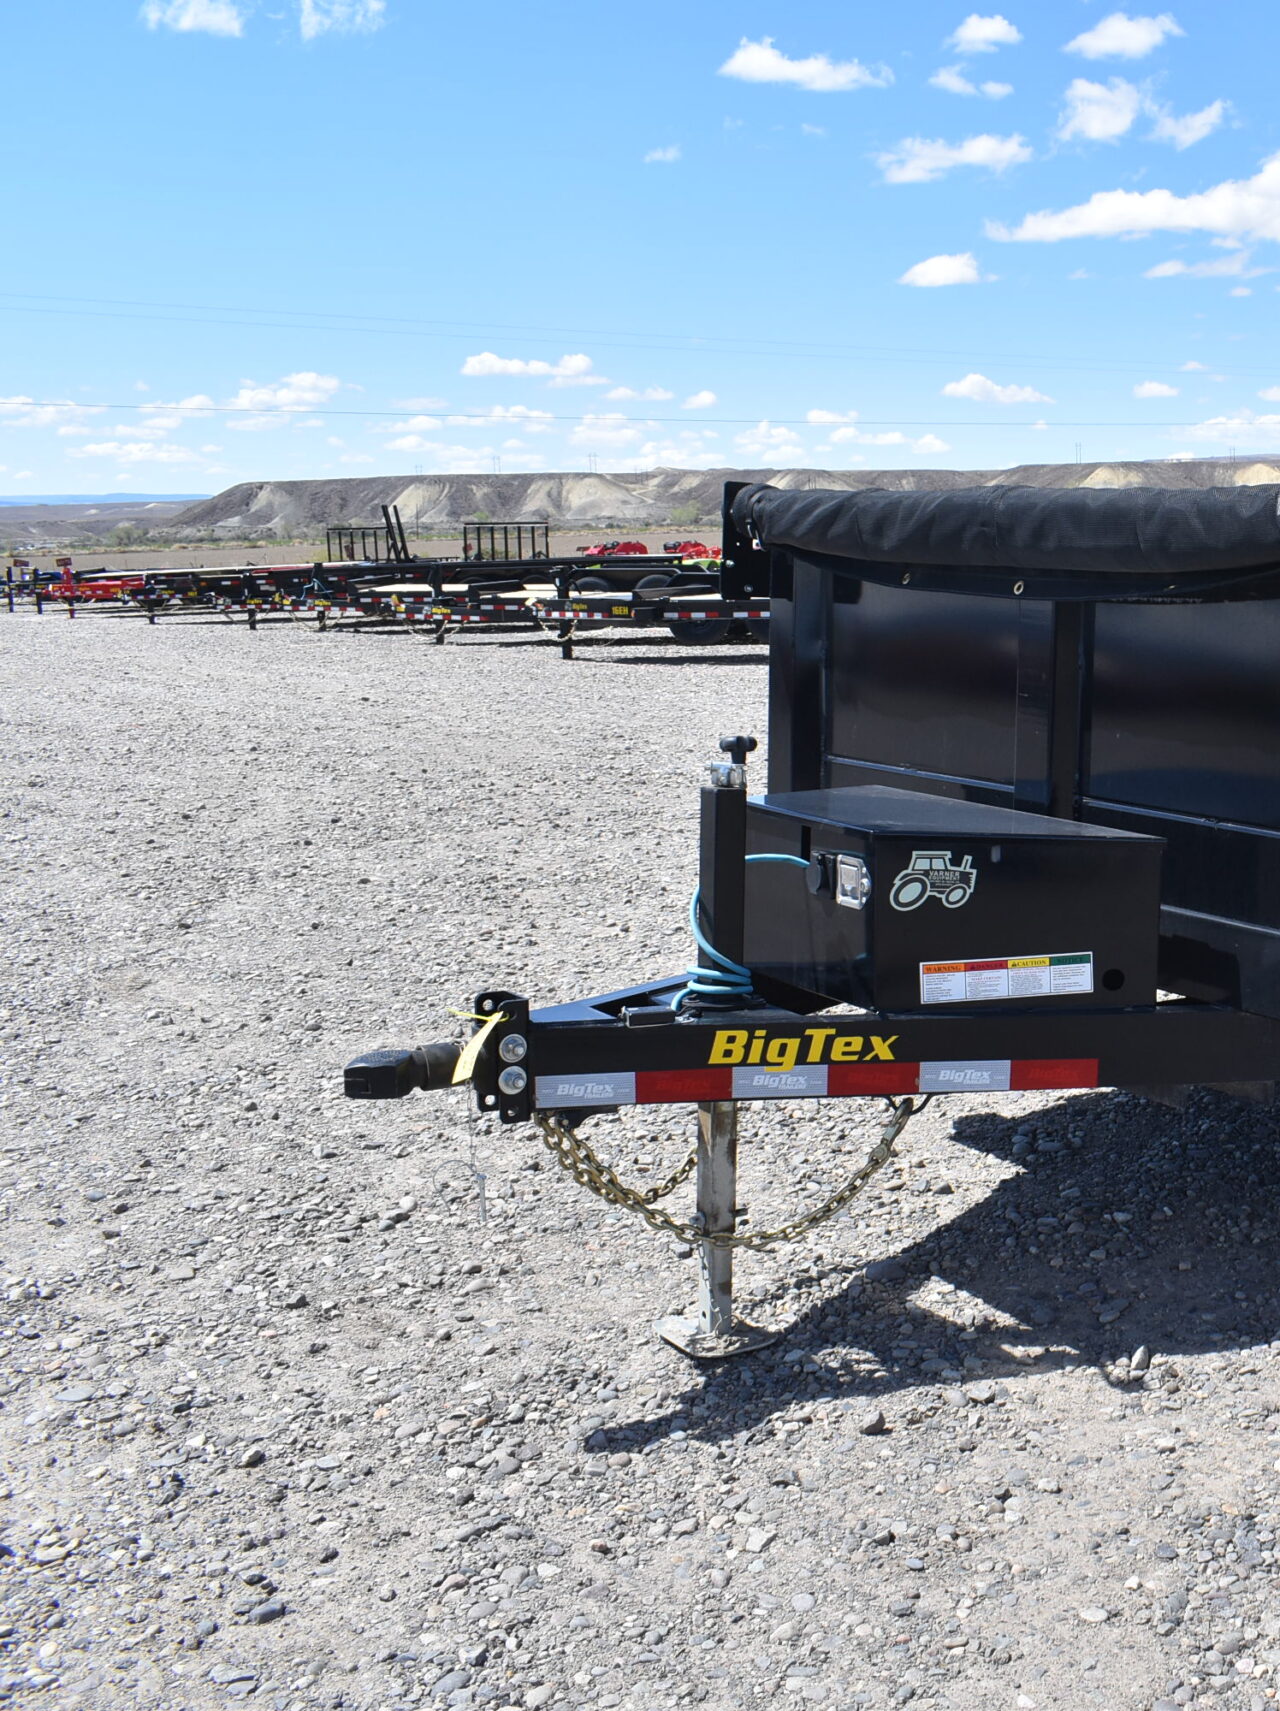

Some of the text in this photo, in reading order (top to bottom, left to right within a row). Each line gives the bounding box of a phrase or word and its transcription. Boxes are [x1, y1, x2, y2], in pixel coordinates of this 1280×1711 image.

[708, 1028, 900, 1072] BigTex
[752, 1074, 808, 1088] BigTex
[938, 1069, 992, 1082] BigTex
[557, 1082, 614, 1098] BigTex
